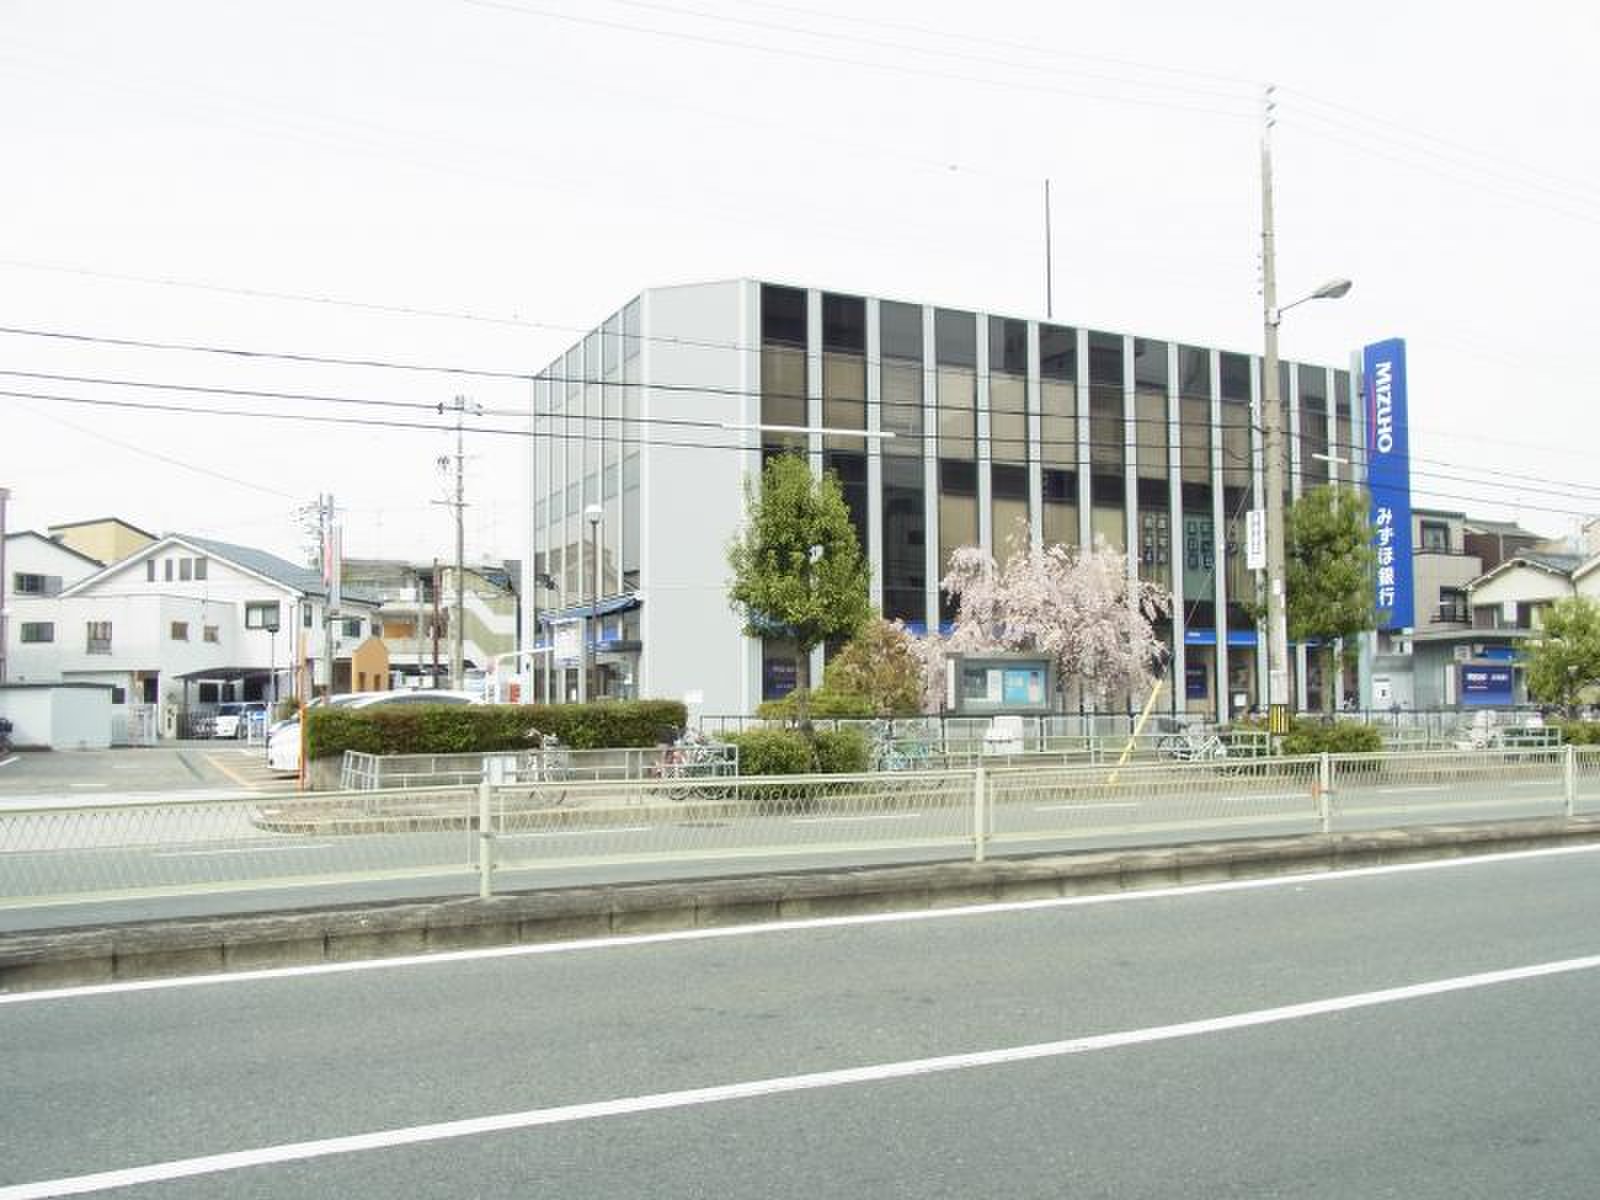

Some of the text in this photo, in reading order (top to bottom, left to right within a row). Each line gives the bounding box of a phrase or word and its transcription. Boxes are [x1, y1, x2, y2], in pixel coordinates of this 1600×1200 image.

[1375, 361, 1393, 453] MIZUHO
[1376, 507, 1394, 606] みずほ銀行
